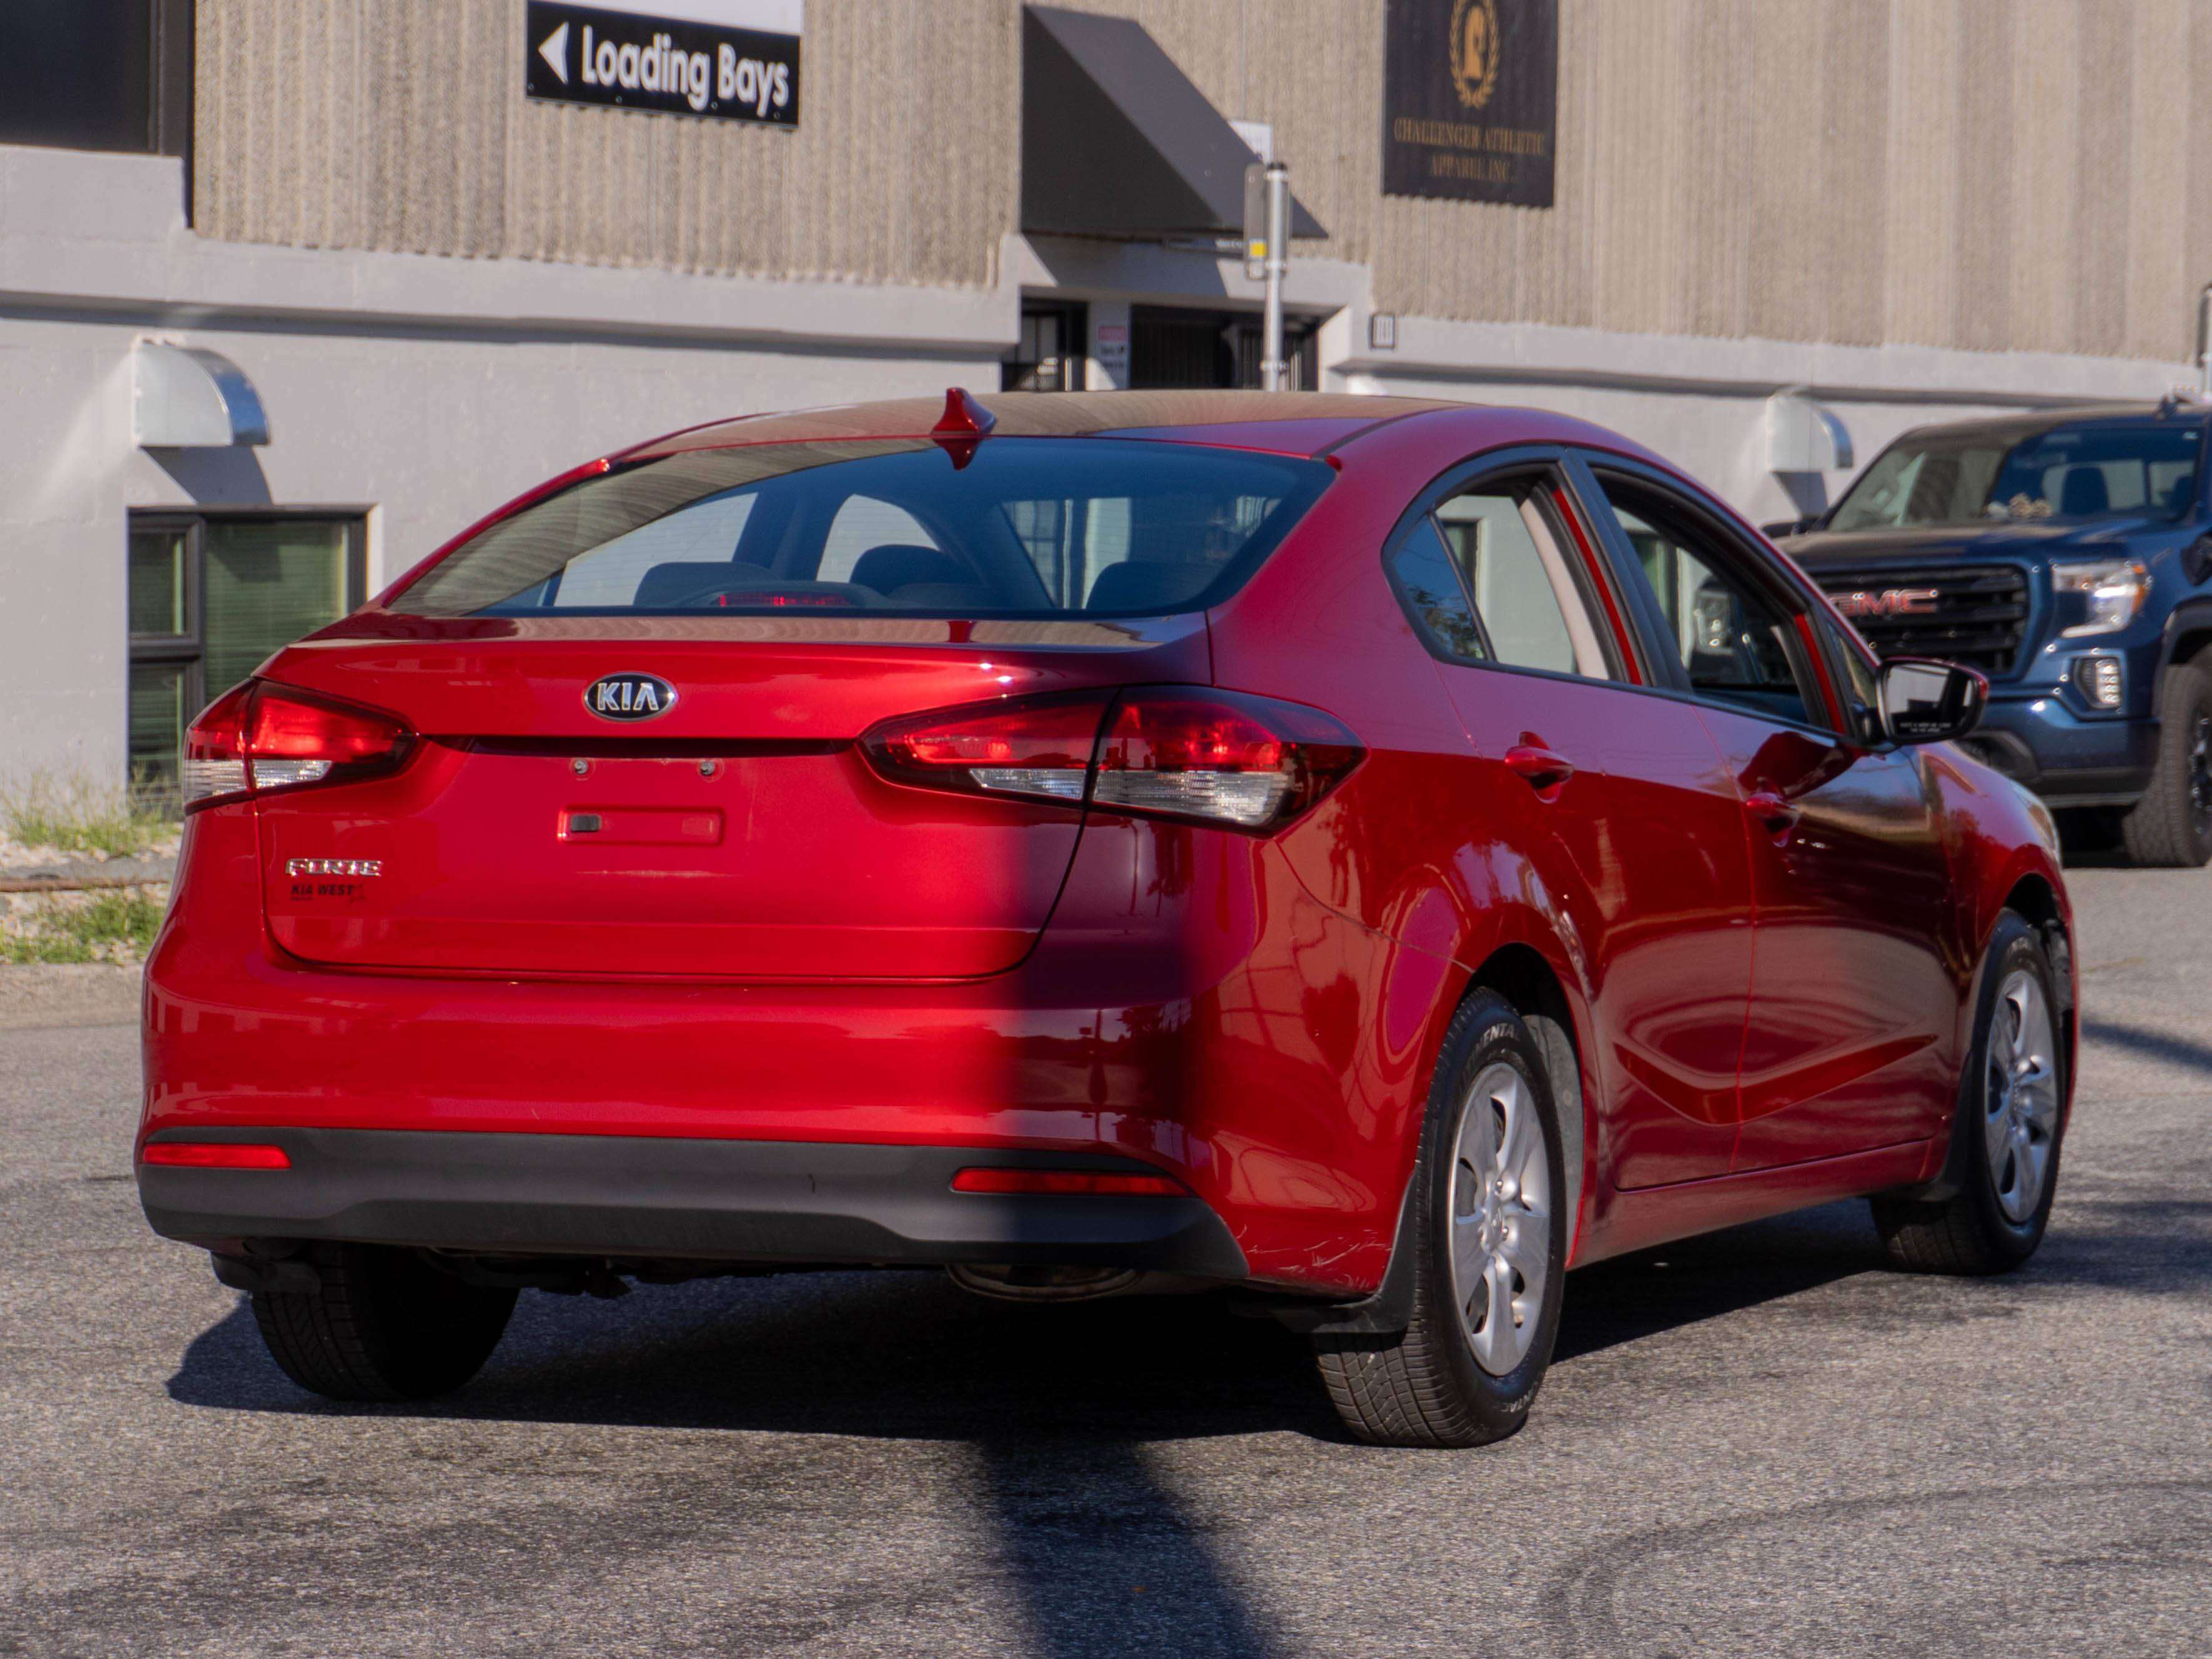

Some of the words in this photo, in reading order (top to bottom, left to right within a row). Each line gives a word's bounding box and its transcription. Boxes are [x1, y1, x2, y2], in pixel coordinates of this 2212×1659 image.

[582, 25, 710, 111] Loading
[718, 43, 789, 117] Bays
[1394, 117, 1480, 148] CHALLENGER
[1483, 127, 1544, 155] ATHLETIC
[1826, 589, 1938, 615] GMC
[597, 682, 659, 710] KIA
[285, 858, 382, 876] FORTE
[291, 884, 313, 894] KIA
[318, 884, 355, 895] WEST
